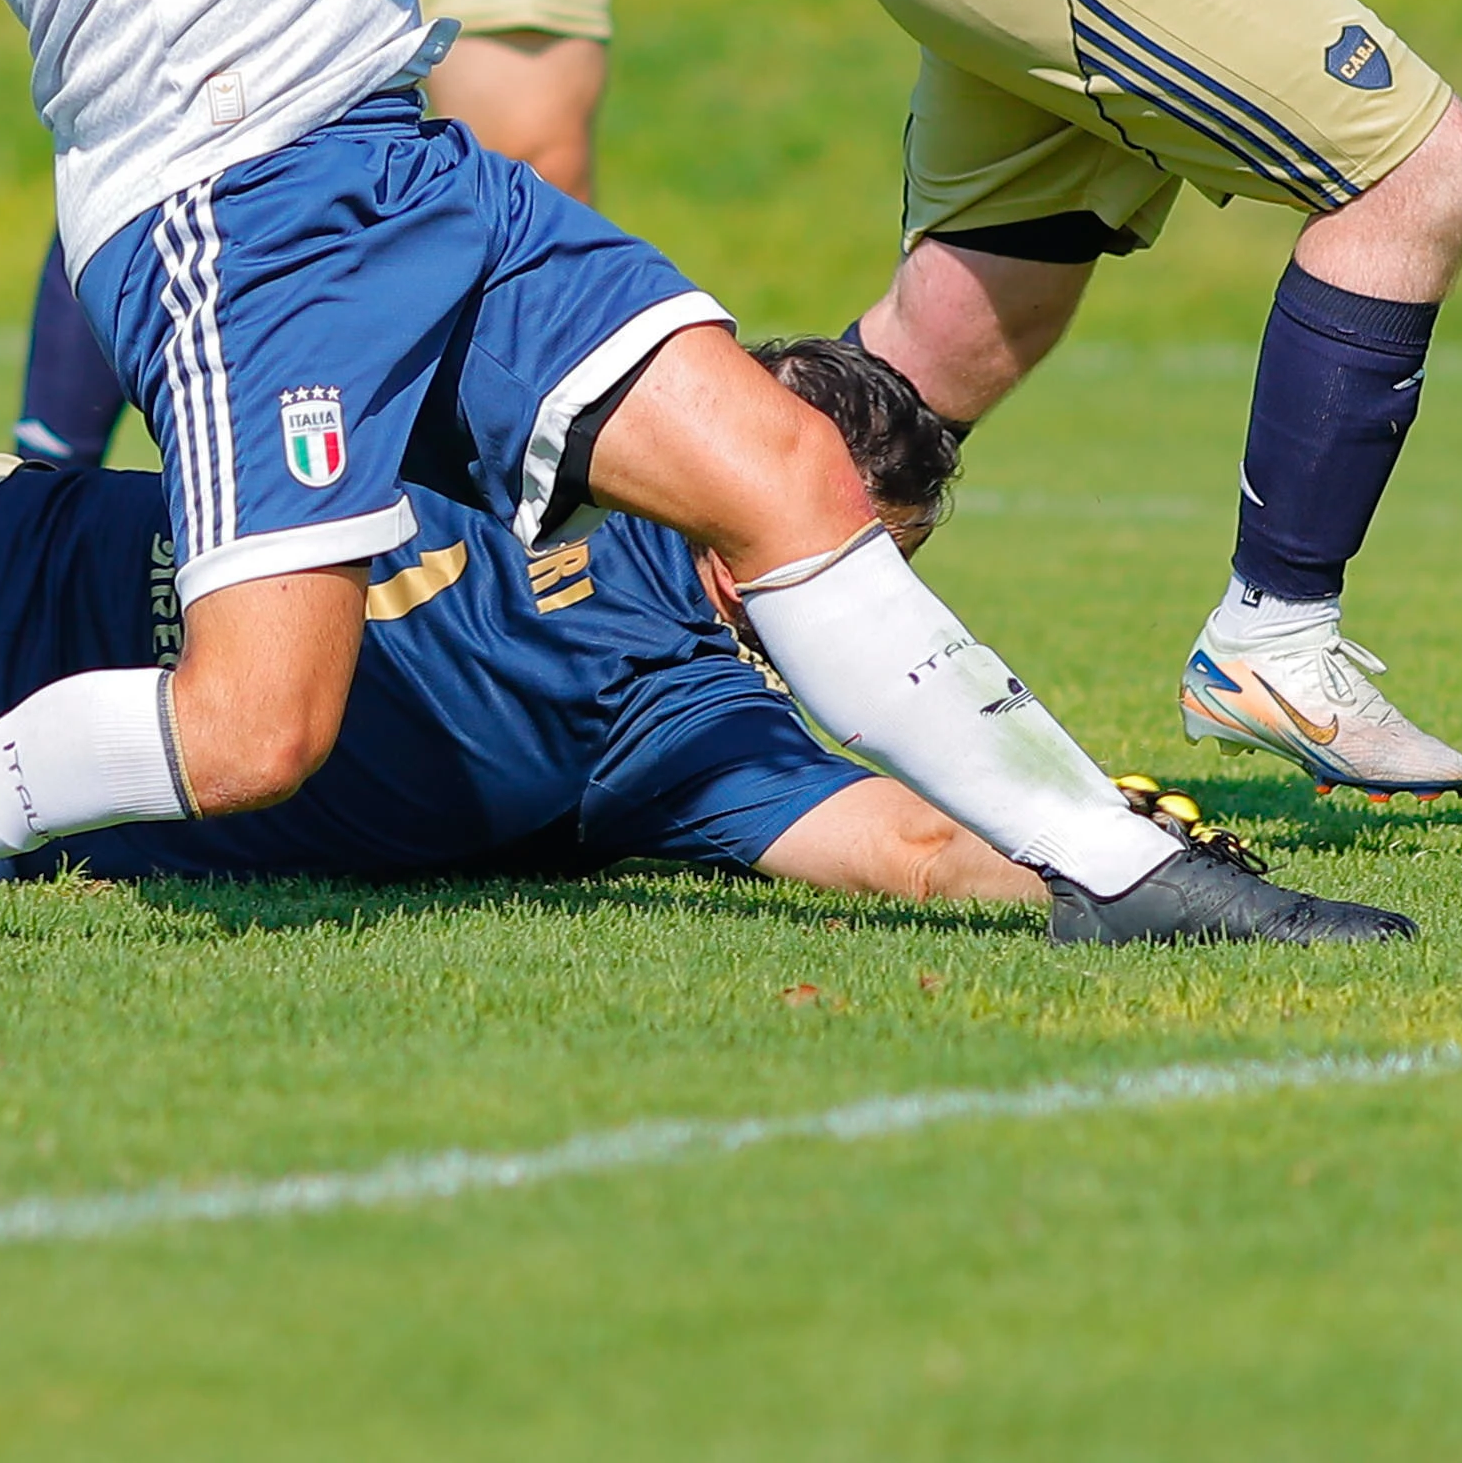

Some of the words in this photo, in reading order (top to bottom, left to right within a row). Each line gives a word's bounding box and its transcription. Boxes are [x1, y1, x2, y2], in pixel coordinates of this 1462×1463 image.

[1340, 38, 1376, 79] CABJ
[289, 411, 335, 428] ITALIA
[907, 638, 978, 685] ITAL
